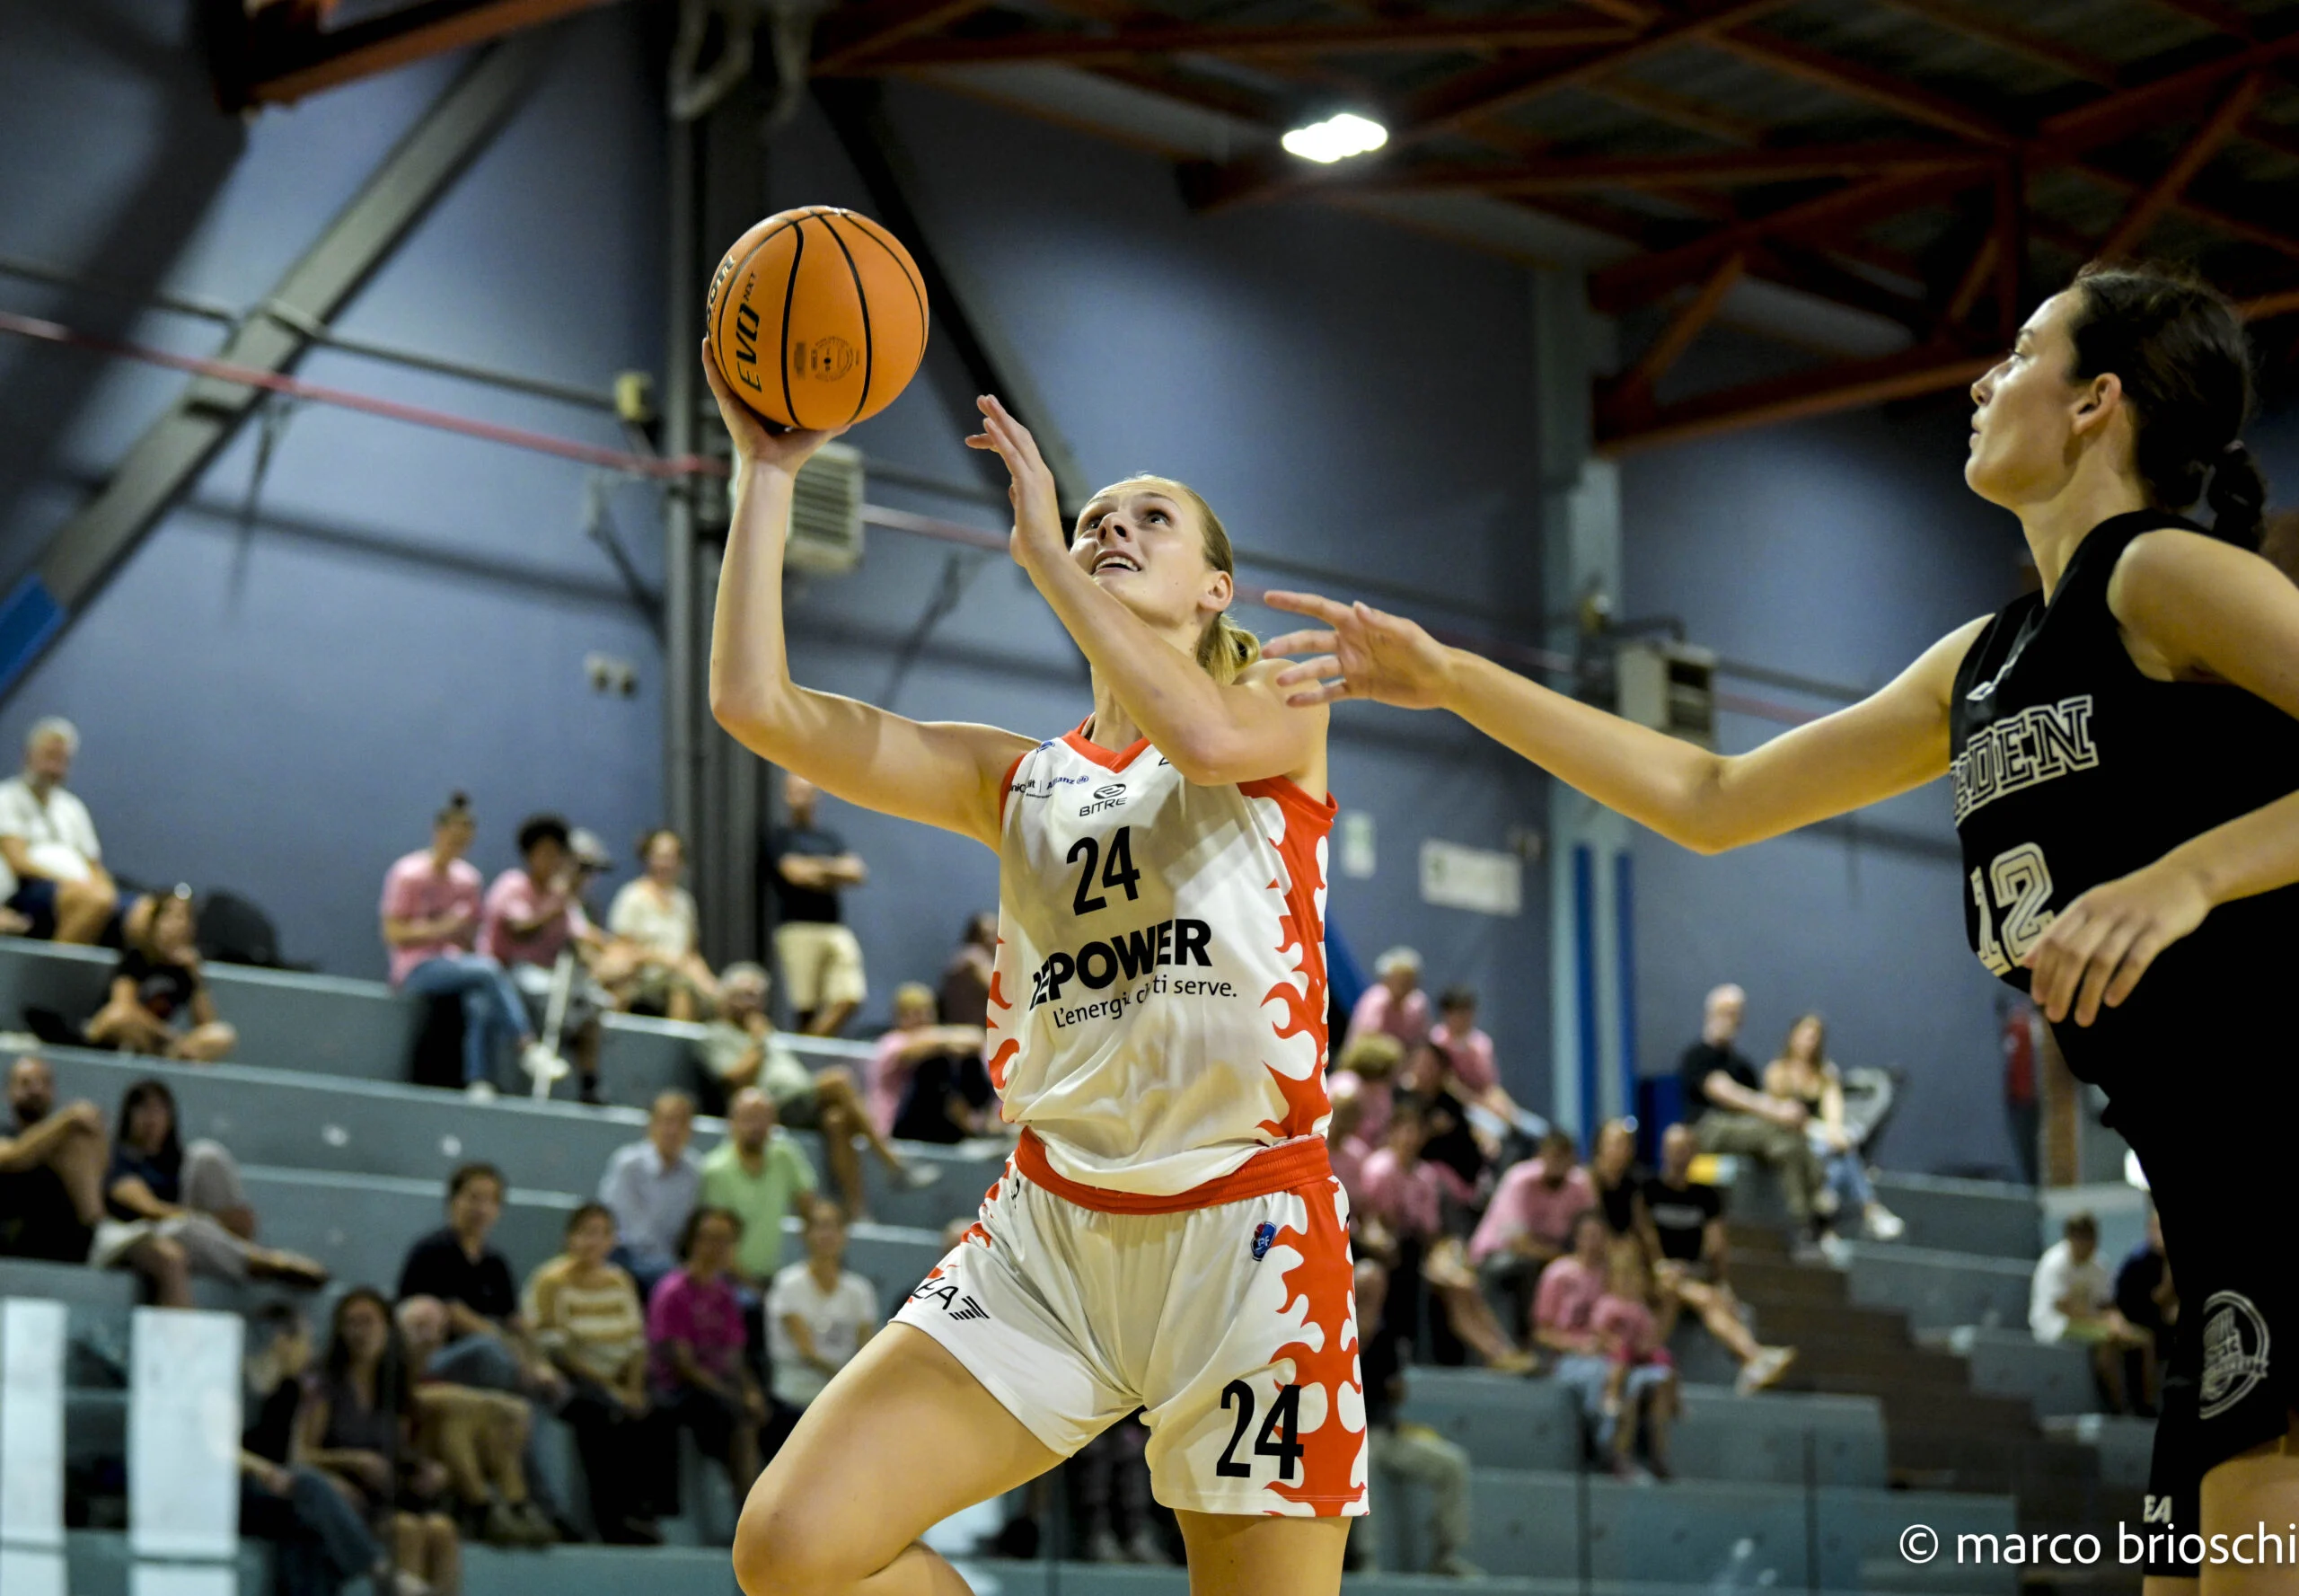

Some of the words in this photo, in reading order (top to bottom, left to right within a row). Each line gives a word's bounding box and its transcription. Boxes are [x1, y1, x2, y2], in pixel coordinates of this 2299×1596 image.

[736, 303, 762, 393] EVO
[1079, 797, 1128, 816] BITRE
[1066, 825, 1141, 916] 24
[1970, 842, 2056, 978] 12
[1153, 974, 1167, 993] ti
[1174, 979, 1238, 998] serve.
[1216, 1379, 1304, 1480] 24
